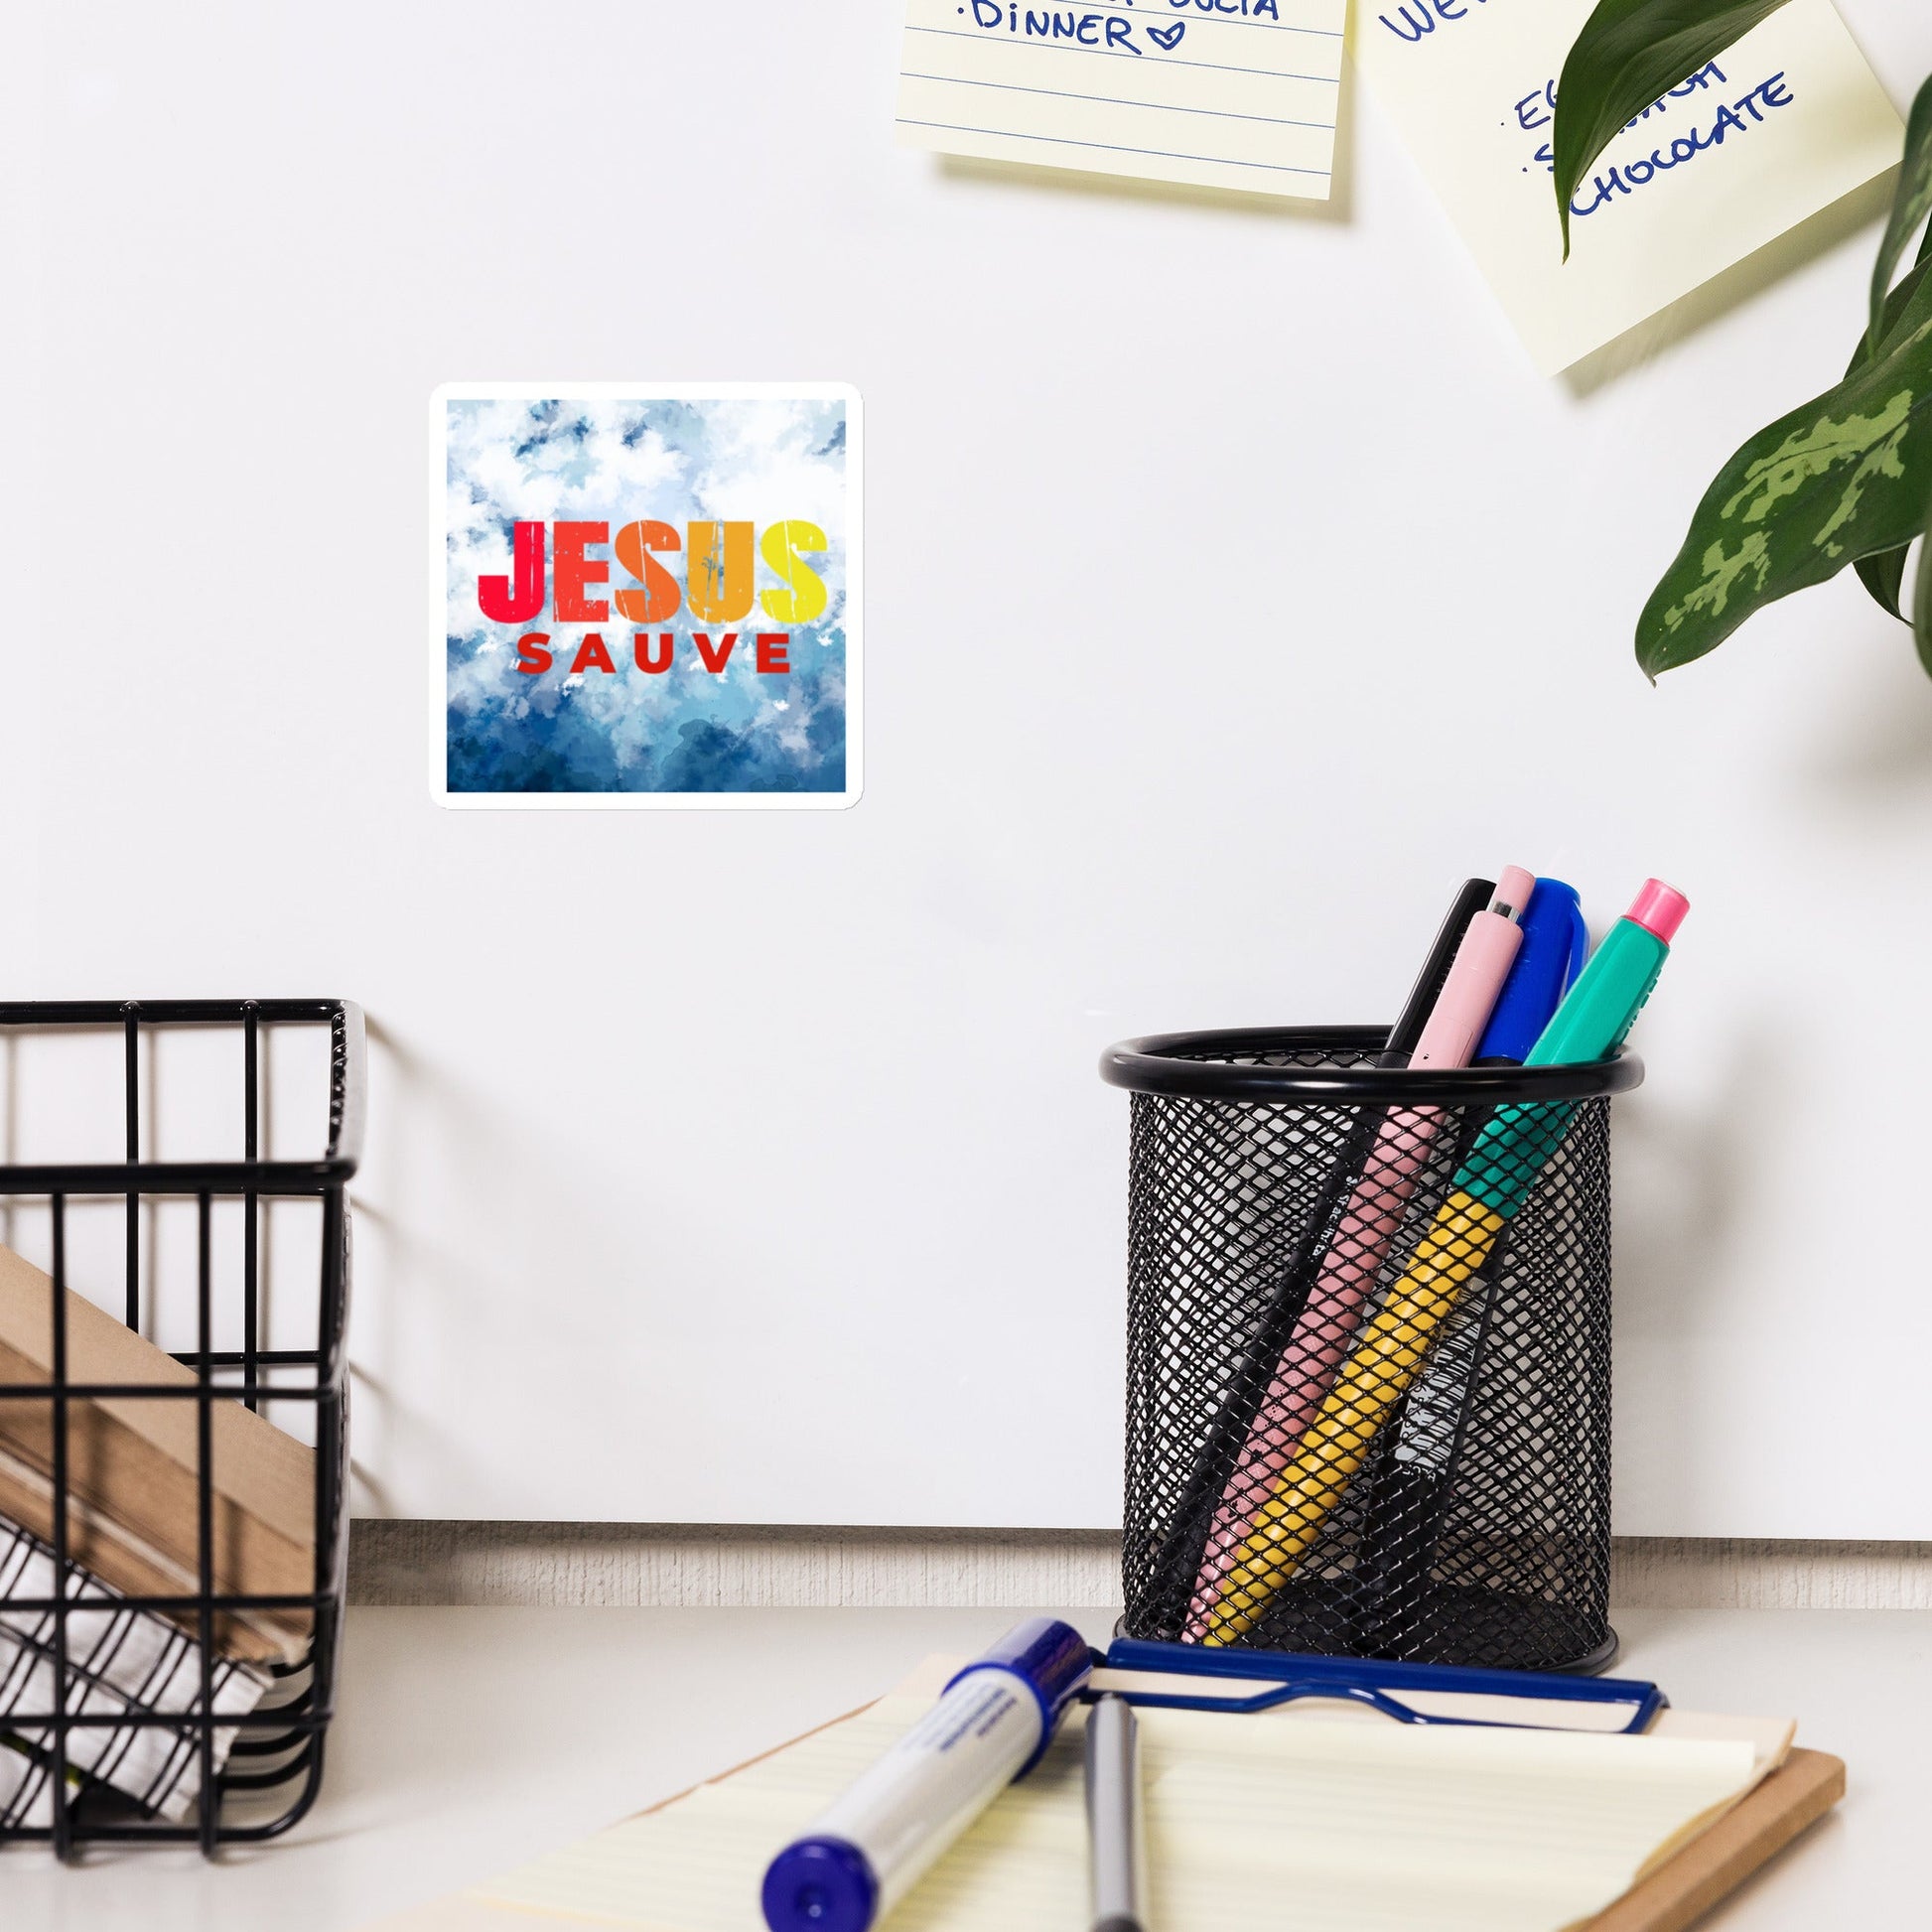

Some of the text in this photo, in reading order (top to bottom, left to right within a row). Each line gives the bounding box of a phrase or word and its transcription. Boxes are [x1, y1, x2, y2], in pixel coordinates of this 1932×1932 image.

[1569, 70, 1794, 216] CHOCOLATE
[478, 519, 828, 624] JESUS
[516, 632, 791, 674] SAUVE
